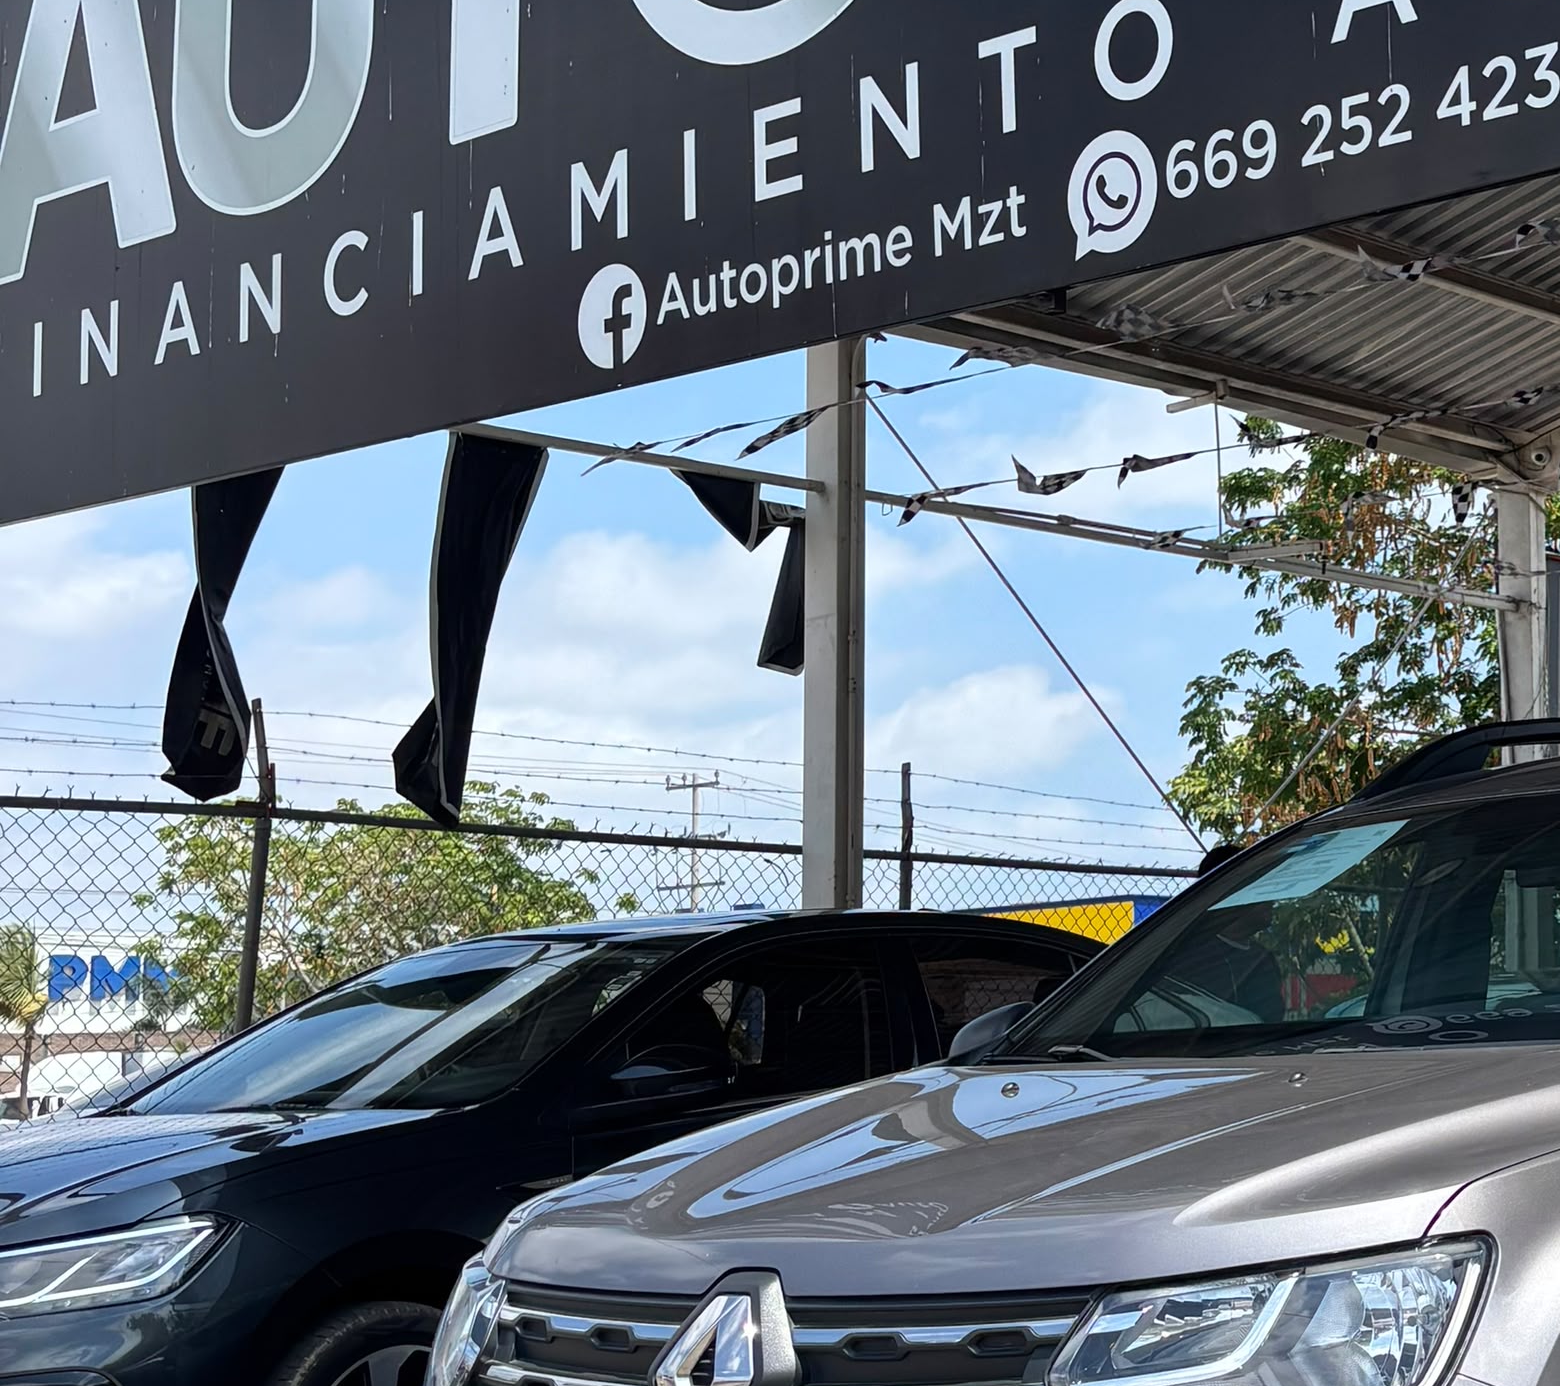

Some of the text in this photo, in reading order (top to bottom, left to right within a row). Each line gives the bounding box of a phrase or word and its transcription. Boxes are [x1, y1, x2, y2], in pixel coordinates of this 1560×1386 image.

[1165, 119, 1278, 199] 669
[1300, 83, 1413, 168] 252
[656, 185, 1028, 326] Autoprime Mzt
